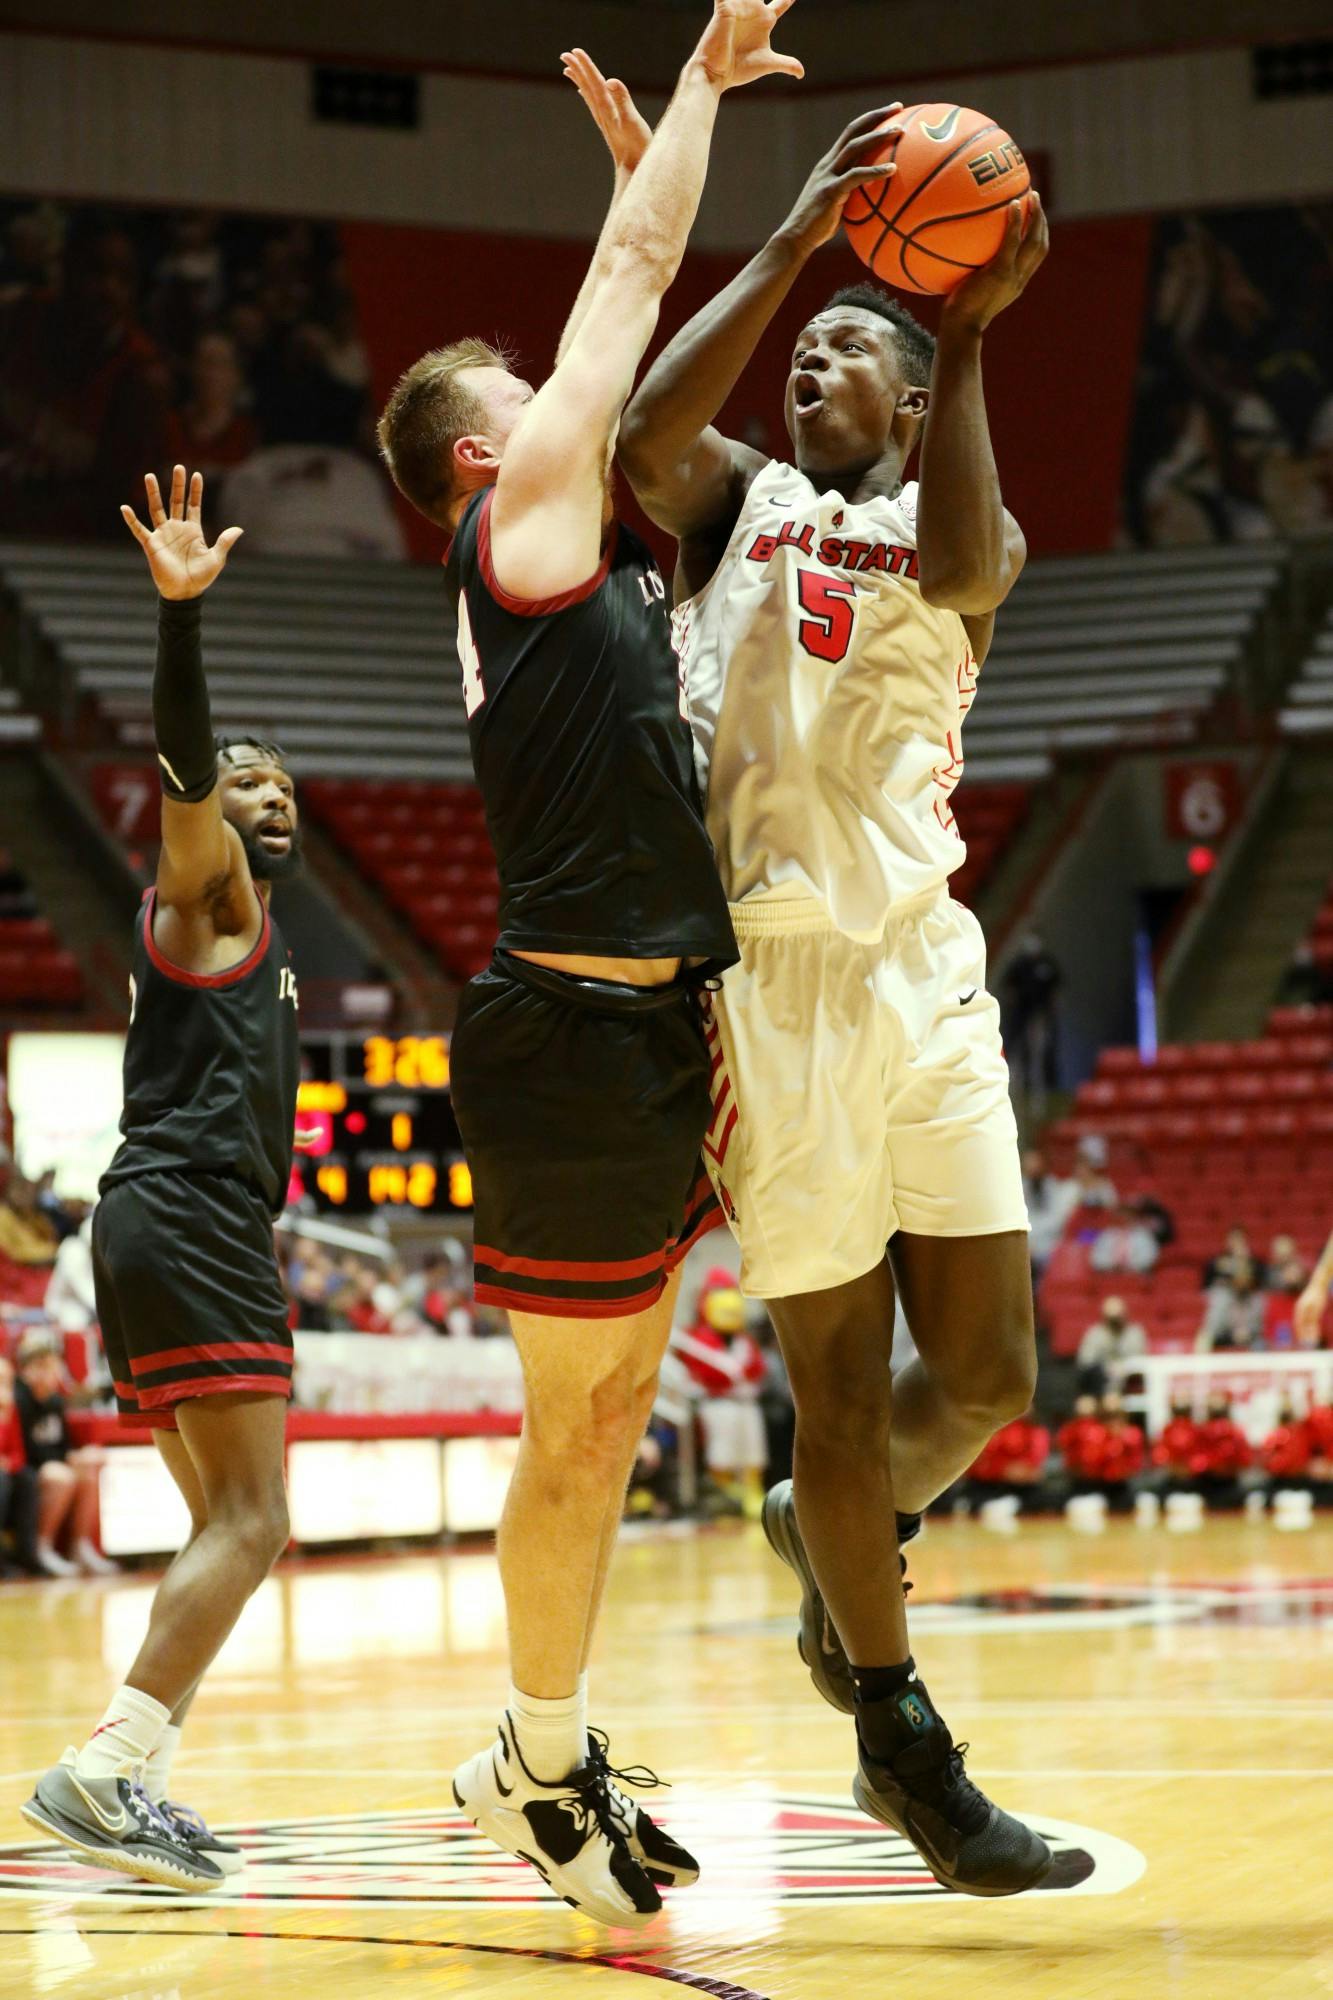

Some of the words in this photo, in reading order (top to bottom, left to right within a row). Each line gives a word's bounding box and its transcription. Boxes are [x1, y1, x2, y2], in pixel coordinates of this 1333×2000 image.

[797, 567, 857, 664] 5
[109, 780, 149, 834] 7
[1182, 779, 1225, 837] 6
